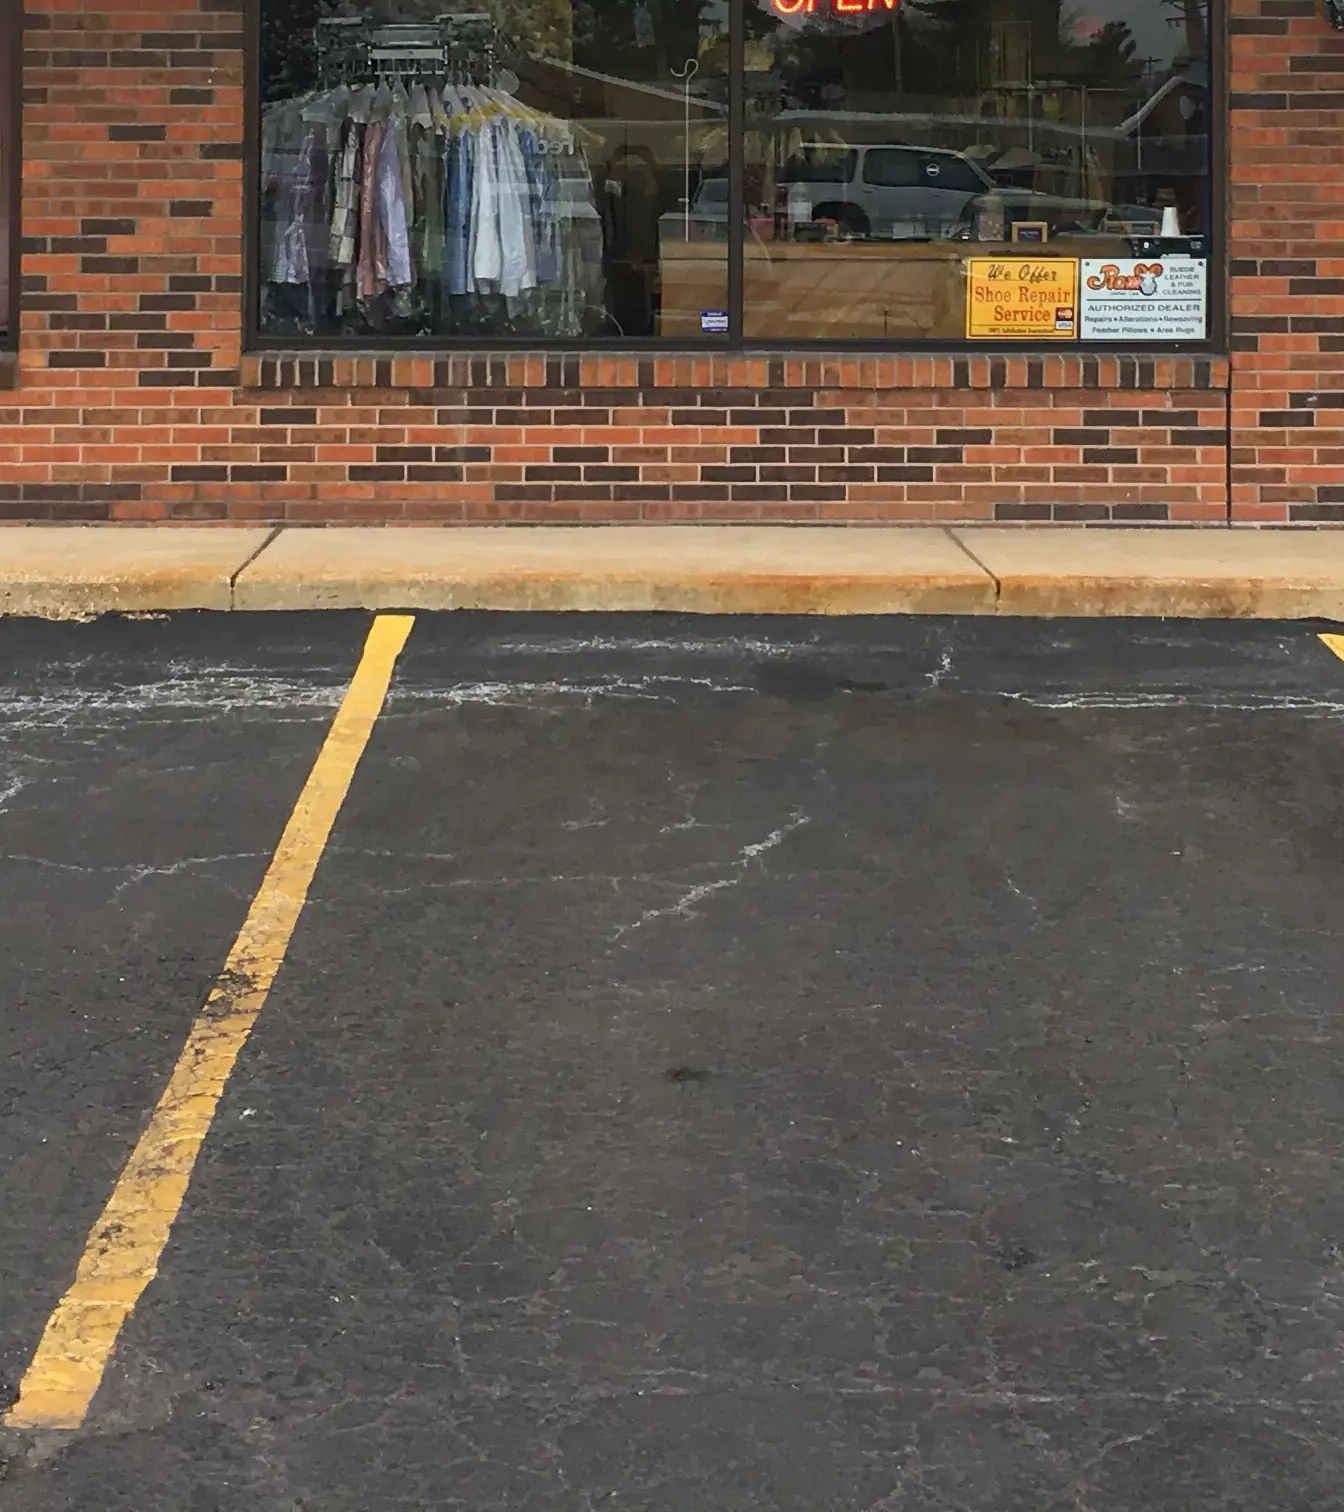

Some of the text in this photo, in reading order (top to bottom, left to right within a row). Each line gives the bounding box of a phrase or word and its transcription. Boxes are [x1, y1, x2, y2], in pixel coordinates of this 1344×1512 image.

[987, 263, 1057, 284] We Offer
[974, 285, 1071, 307] Shoe Repair
[993, 305, 1051, 322] Service
[1087, 304, 1201, 312] AUTHORIZED DEALER
[1084, 315, 1203, 324] Repairs Alterations Reweaving
